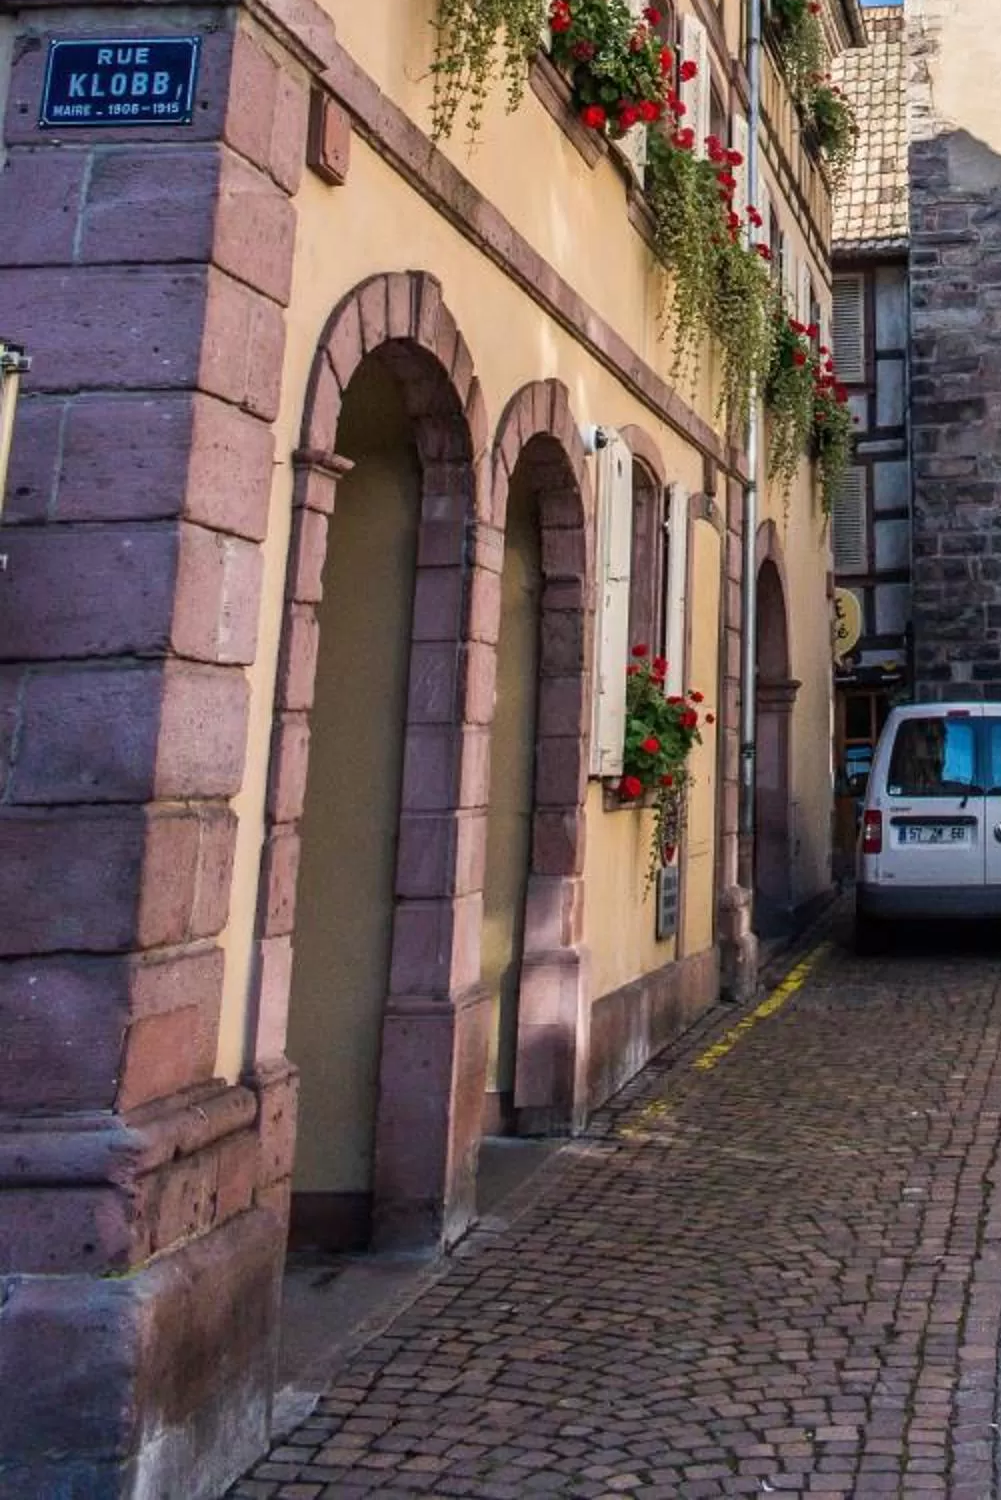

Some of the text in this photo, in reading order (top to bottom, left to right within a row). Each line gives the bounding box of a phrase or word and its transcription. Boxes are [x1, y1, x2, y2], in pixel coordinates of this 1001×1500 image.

[97, 47, 151, 65] RUE
[68, 71, 171, 97] KLOBB
[52, 104, 92, 116] MAIRE
